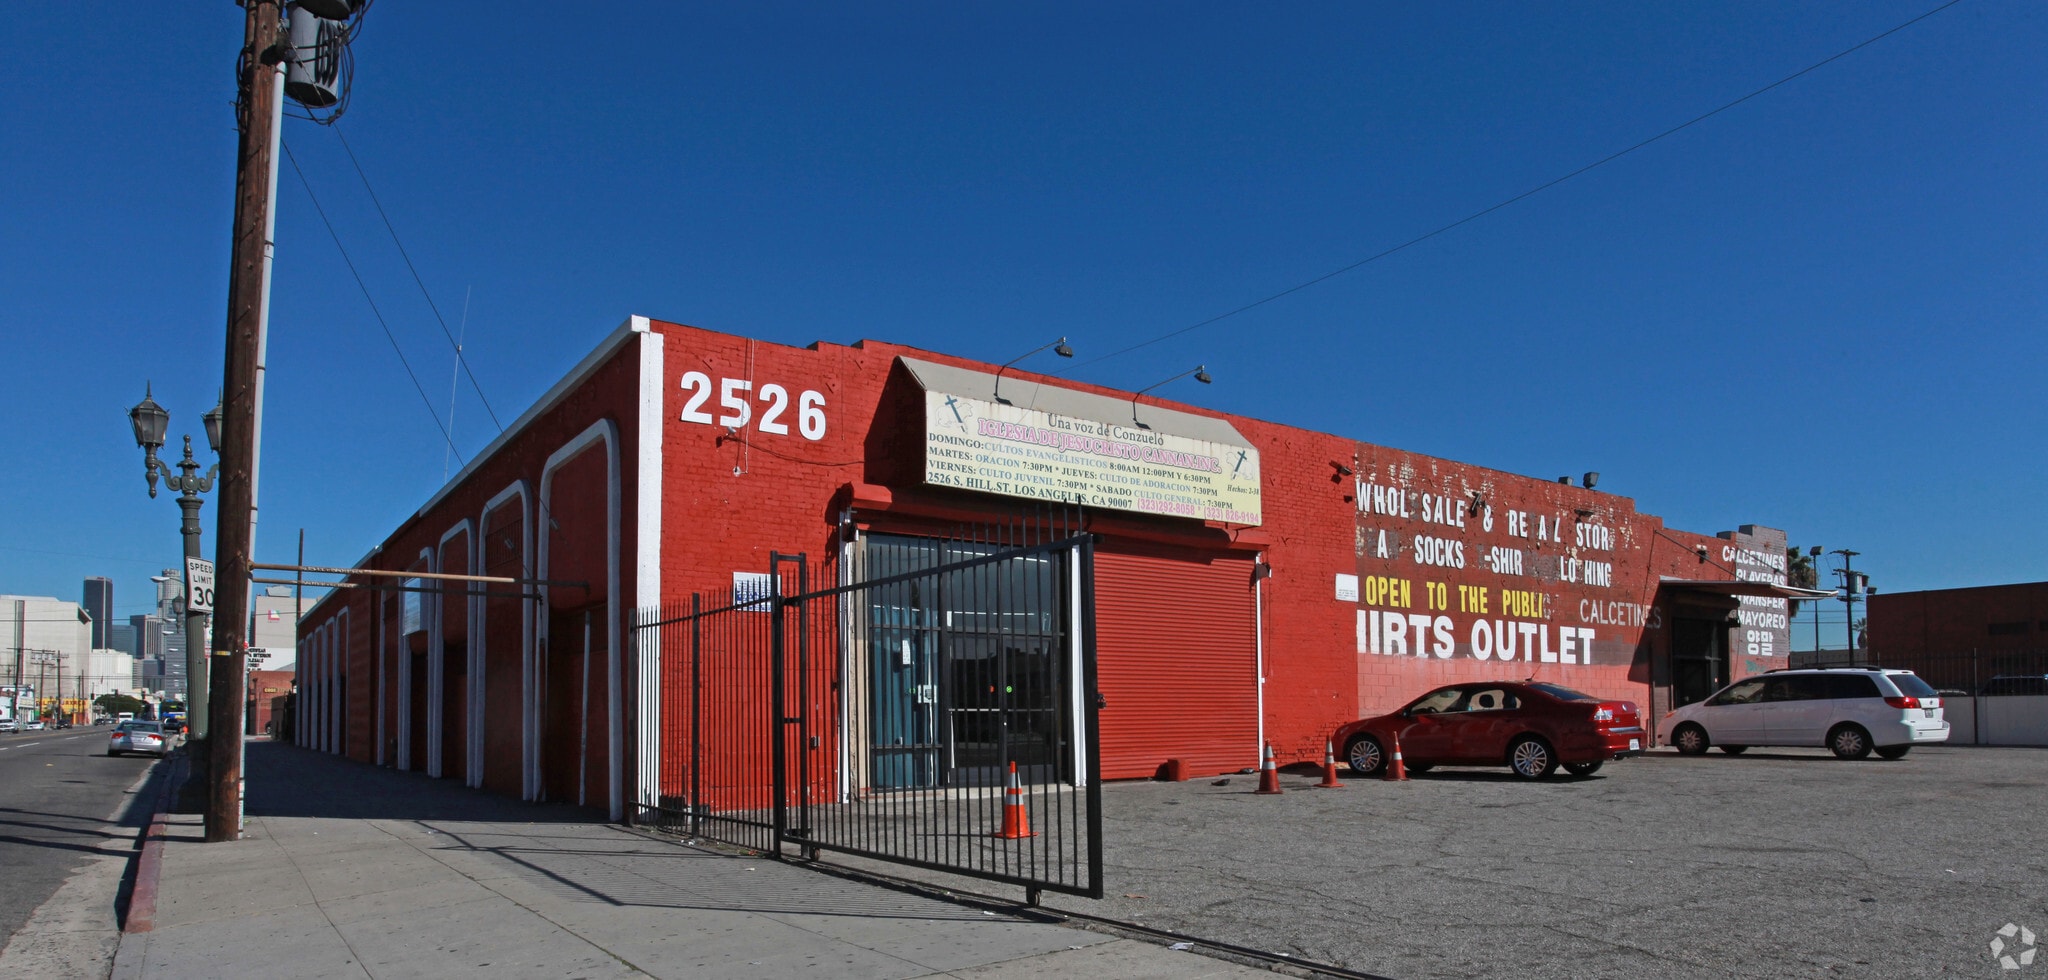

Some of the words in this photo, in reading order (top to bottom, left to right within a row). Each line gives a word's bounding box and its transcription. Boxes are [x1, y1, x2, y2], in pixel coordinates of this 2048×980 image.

[681, 370, 826, 441] 2526
[978, 417, 1037, 444] IGLESIA
[1038, 428, 1059, 448] DE
[1059, 432, 1141, 462] JESUCRISTO
[1048, 413, 1071, 430] Una
[1074, 422, 1094, 434] voz
[1097, 423, 1110, 436] de
[1113, 426, 1164, 446] Conzuelo
[929, 446, 973, 461] MARTES:
[975, 453, 1020, 468] ORACION
[1022, 461, 1053, 473] 7:30PM
[1061, 467, 1098, 480] JUEVES:
[1099, 473, 1128, 484] CULTO
[1130, 477, 1141, 486] DE
[1143, 479, 1191, 492] ADORACION
[1193, 486, 1218, 496] 7:30PM
[929, 459, 976, 475] VIERNES:
[979, 467, 1013, 479] CULTO
[1014, 473, 1055, 487] JUVENIL
[1057, 479, 1087, 490] 7:30PM
[1096, 485, 1132, 497] SABADO
[1134, 490, 1162, 500] CULTO
[1207, 499, 1233, 509] 7:30PM
[1026, 449, 1108, 469] EVANGELISTICOS
[1109, 462, 1140, 474] 8:00AM
[1142, 468, 1174, 478] 12:00PM
[1184, 473, 1211, 484] 6:30PM
[927, 471, 951, 484] 2526
[953, 476, 963, 487] S.
[1014, 485, 1036, 497] LOS
[1091, 495, 1106, 506] CA
[1108, 497, 1133, 509] 90007
[1203, 506, 1224, 520] (323)
[1225, 509, 1259, 523] 826-9194
[1482, 504, 1494, 533] &
[1576, 522, 1611, 551] STOR
[189, 562, 213, 574] SPEED
[1414, 534, 1465, 569] SOCKS
[1722, 545, 1785, 571] CALCETINES
[193, 574, 212, 584] LIMIT
[194, 586, 214, 607] 30
[1365, 575, 1411, 609] OPEN
[1426, 581, 1447, 611] TO
[1458, 584, 1488, 614] THE
[1580, 598, 1662, 629] CALCETINES
[1737, 609, 1786, 629] MAYOREO
[1471, 618, 1596, 665] OUTLET
[1747, 630, 1773, 657] 양말
